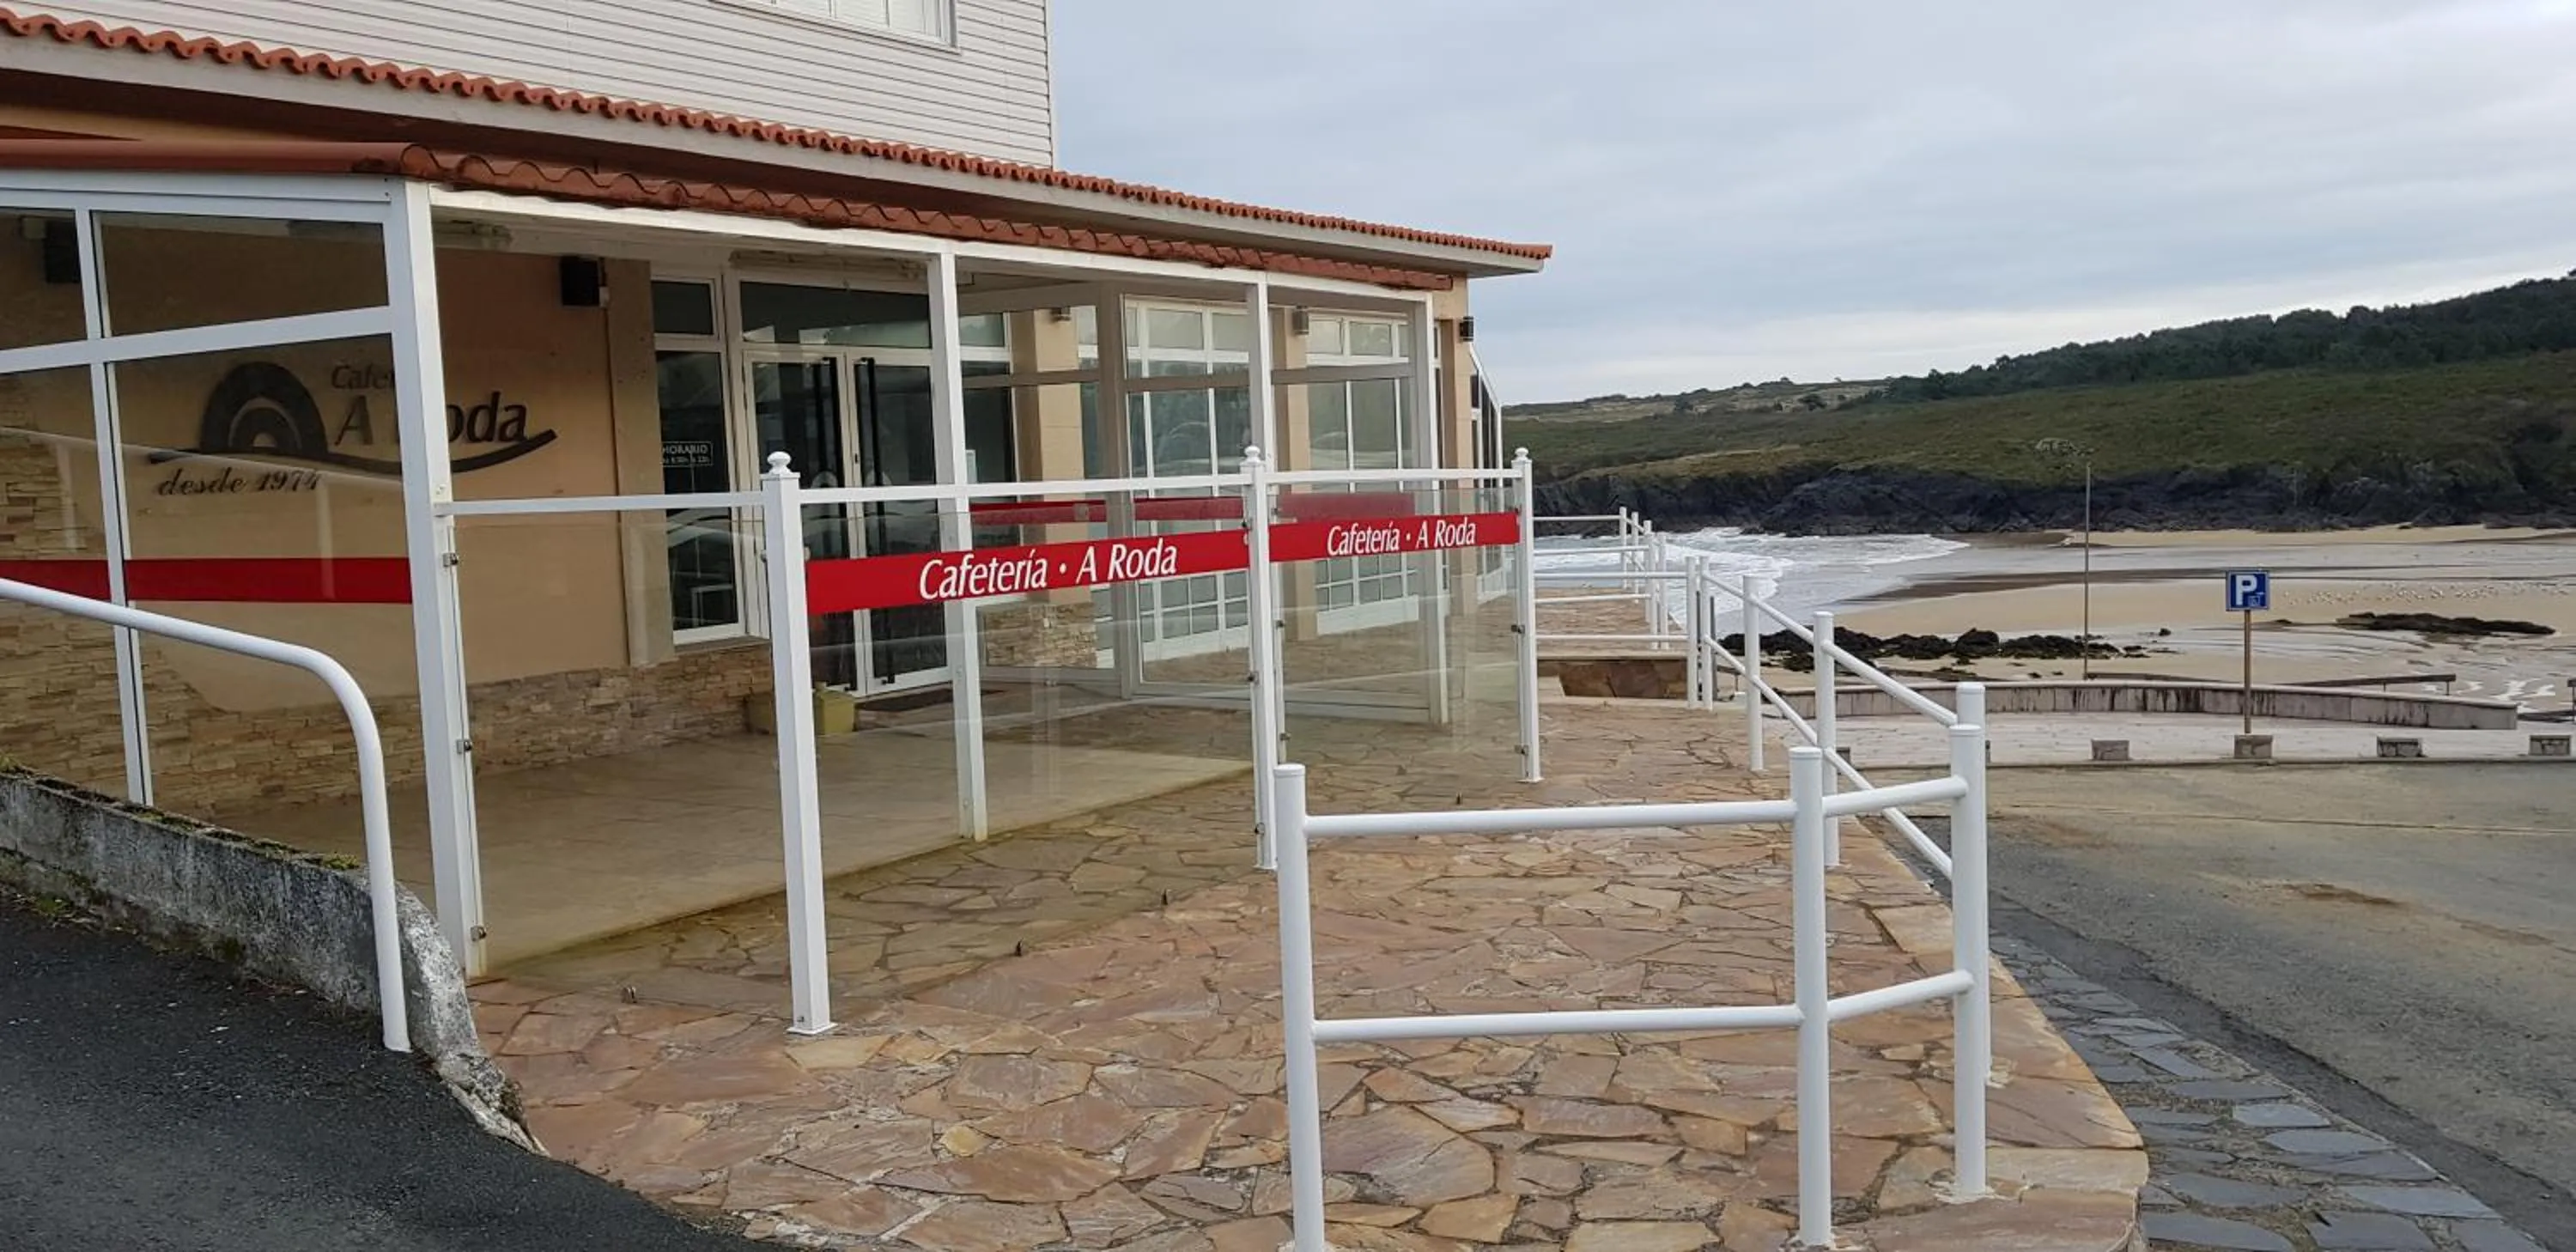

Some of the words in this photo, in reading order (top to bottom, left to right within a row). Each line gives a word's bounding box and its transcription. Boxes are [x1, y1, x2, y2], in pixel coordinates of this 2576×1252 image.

[334, 395, 374, 446] A
[444, 391, 528, 443] oda
[157, 466, 247, 495] desde
[255, 470, 321, 492] 1974
[1327, 521, 1400, 556] Cafetería
[1416, 520, 1429, 548] A
[1433, 516, 1477, 547] Roda
[919, 549, 1048, 600] Cafetería
[1075, 545, 1098, 584] A
[1108, 537, 1177, 578] Roda
[2235, 574, 2257, 605] P
